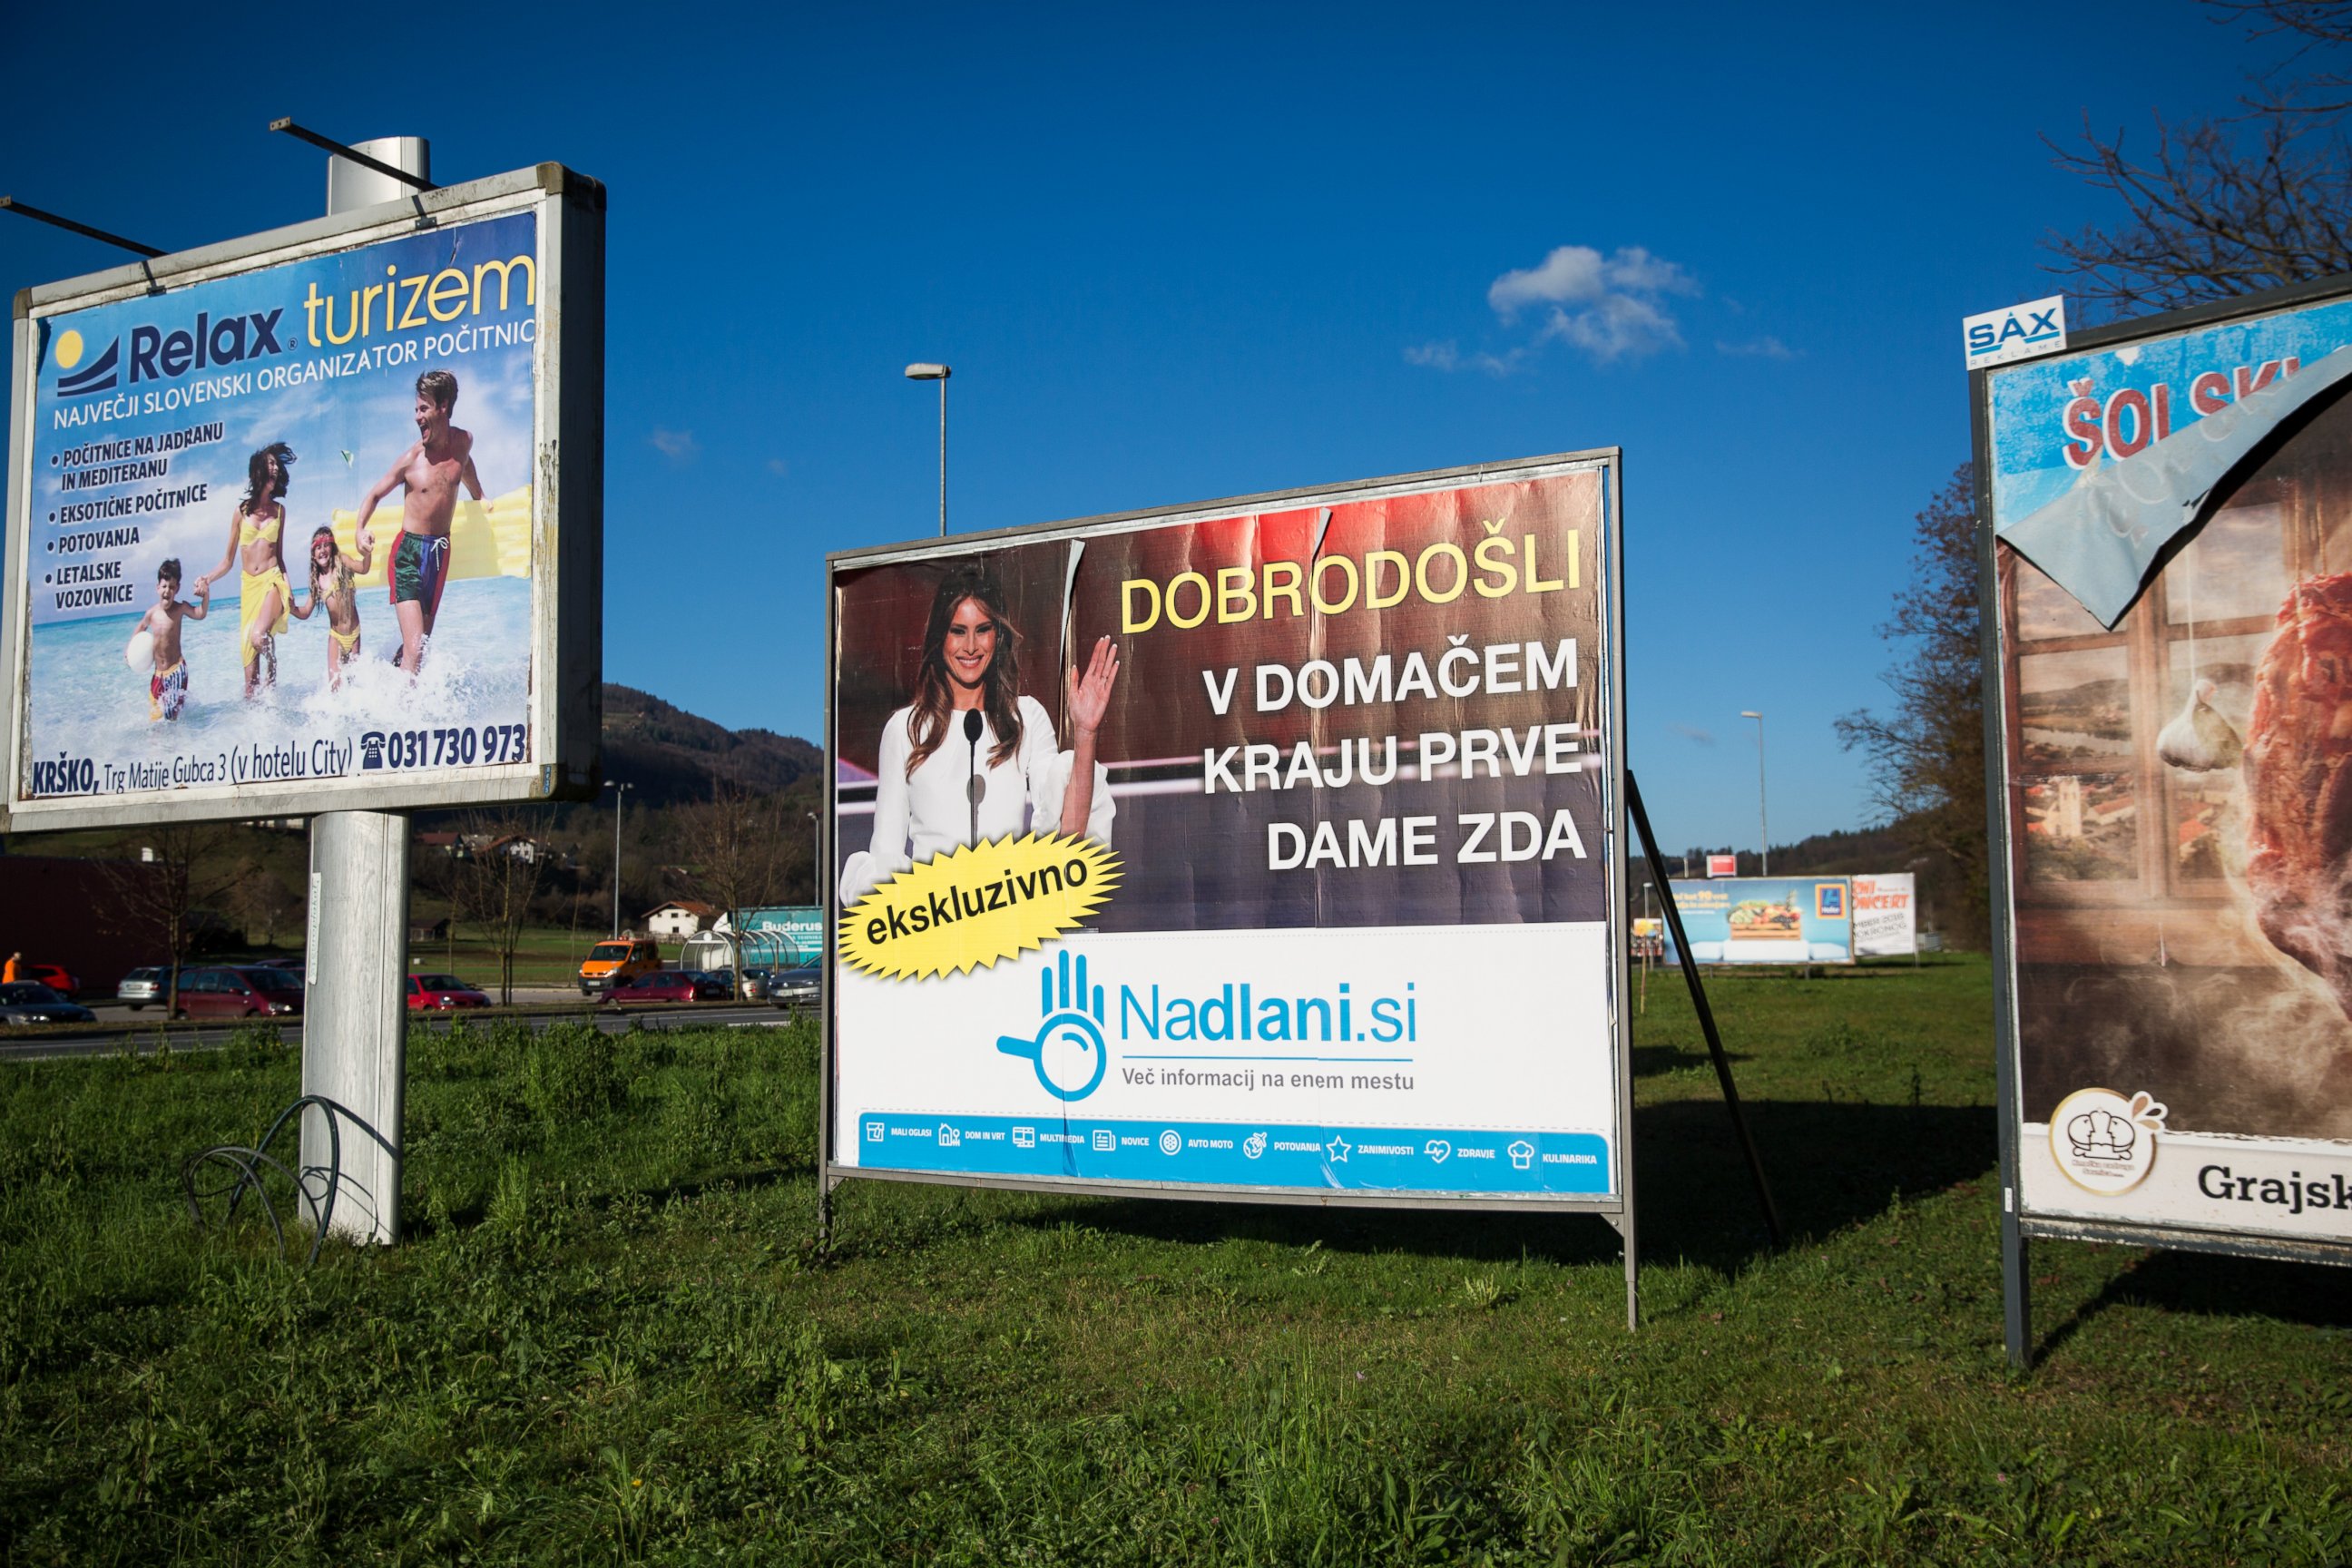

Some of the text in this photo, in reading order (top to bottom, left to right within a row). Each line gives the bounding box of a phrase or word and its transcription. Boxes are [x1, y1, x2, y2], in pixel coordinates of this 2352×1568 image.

[303, 254, 535, 348] turizem
[129, 308, 284, 384] Relax
[1970, 340, 2062, 366] REKLAME
[54, 318, 535, 430] NAJVEČJI SLOVENSKI ORGANIZATOR POČITNIC
[63, 422, 223, 467] POČITNICE NA JADRANU
[62, 458, 168, 491] IN MEDITERANU
[60, 484, 208, 524] EKSOTIČNE POČITNICE
[58, 526, 140, 554] POTOVANJA
[56, 561, 122, 585] LETALSKE
[1121, 517, 1581, 634] DOBRODOŠLI
[55, 583, 133, 609] VOZOVNICE
[1201, 634, 1578, 715] V DOMAČEM
[33, 723, 525, 794] KRŠKO, Trg Matije Gubca 3 (v hotelu City) 031 730 973
[1204, 723, 1583, 794] KRAJU PRVE
[1268, 808, 1588, 870] DAME ZDA
[867, 858, 1088, 945] ekskluzivno
[762, 921, 823, 932] Buderus
[1121, 982, 1416, 1042] Nadlani.si
[1122, 1067, 1414, 1091] Več informacij na enem mestu
[890, 1127, 932, 1137] MALI OGLASI
[965, 1131, 1005, 1141] DOM IN VRT
[1040, 1133, 1085, 1143] MULTIMEDIA
[1121, 1137, 1150, 1146] NOVICE
[1188, 1139, 1233, 1149] AVTO MOTO
[1274, 1142, 1321, 1152] POTOVANJA
[1357, 1144, 1414, 1155] ZANIMIVOSTI
[1457, 1148, 1495, 1159] ZDRAVJE
[1543, 1153, 1597, 1164] KULINARIKA
[2198, 1165, 2352, 1214] Grajsk
